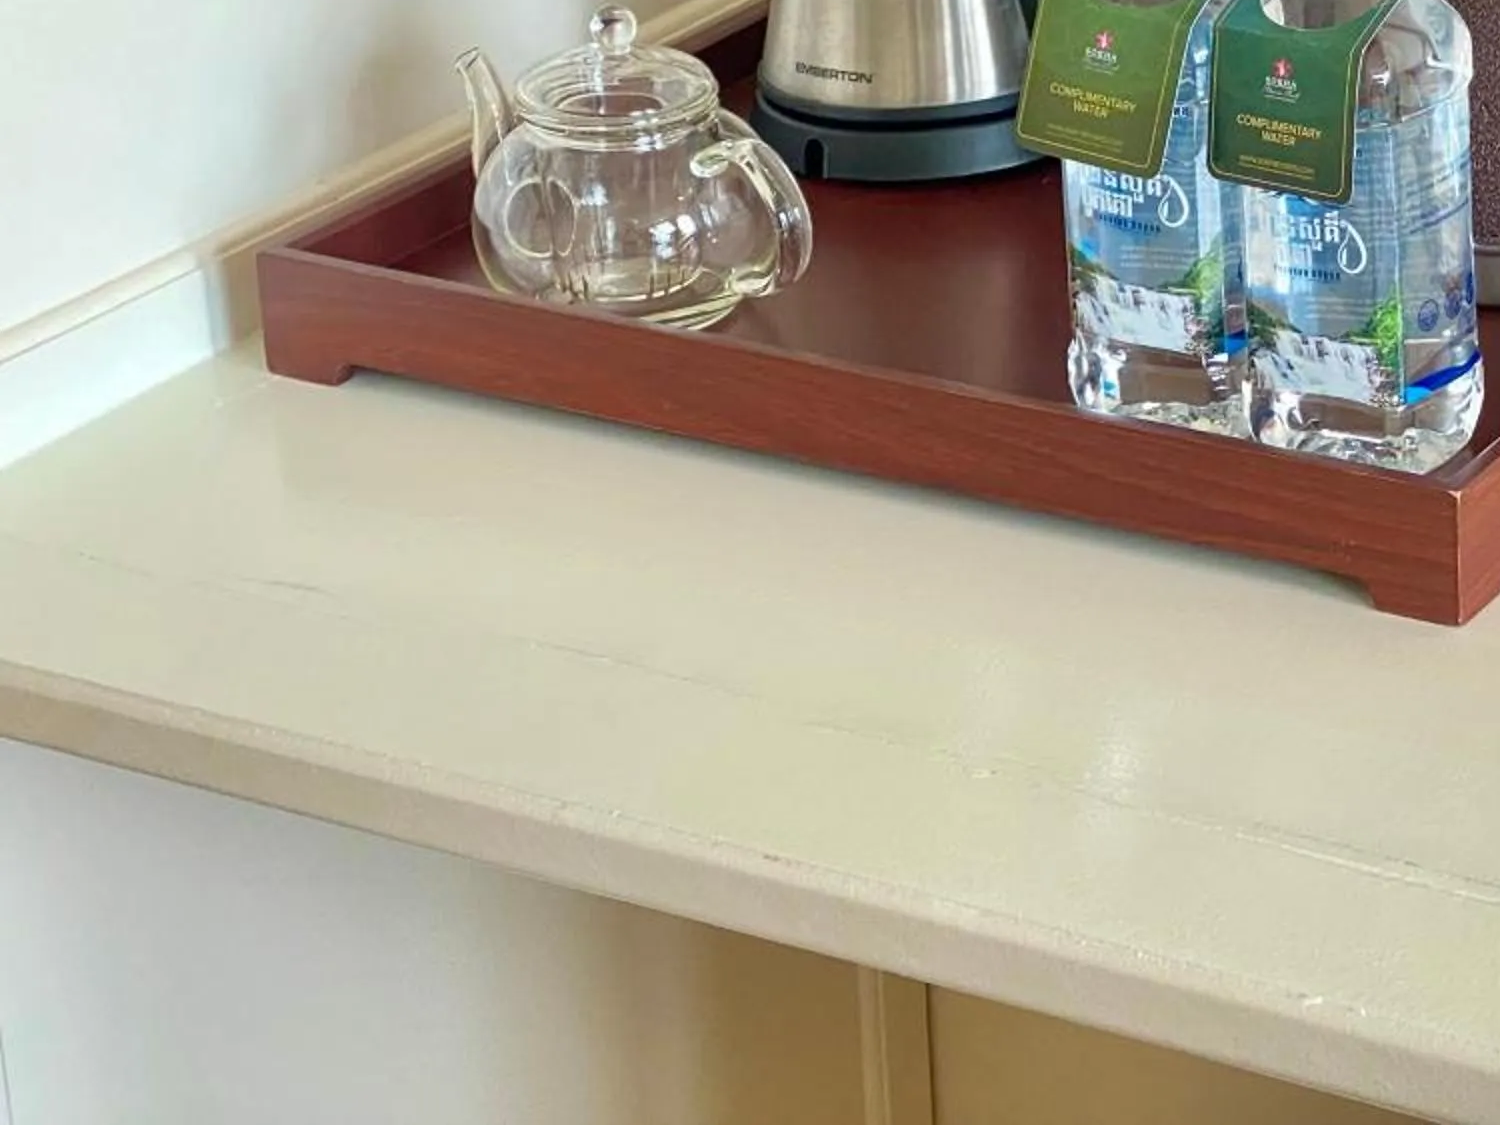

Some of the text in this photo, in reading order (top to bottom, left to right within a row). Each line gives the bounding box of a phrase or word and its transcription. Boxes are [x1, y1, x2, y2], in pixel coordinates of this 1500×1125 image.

[795, 61, 873, 84] EMBERTON
[1049, 81, 1137, 114] COMPLIMENTARY
[1072, 99, 1108, 118] WATER
[1235, 113, 1322, 140] COMPLIMENTARY
[1261, 129, 1296, 146] WATER
